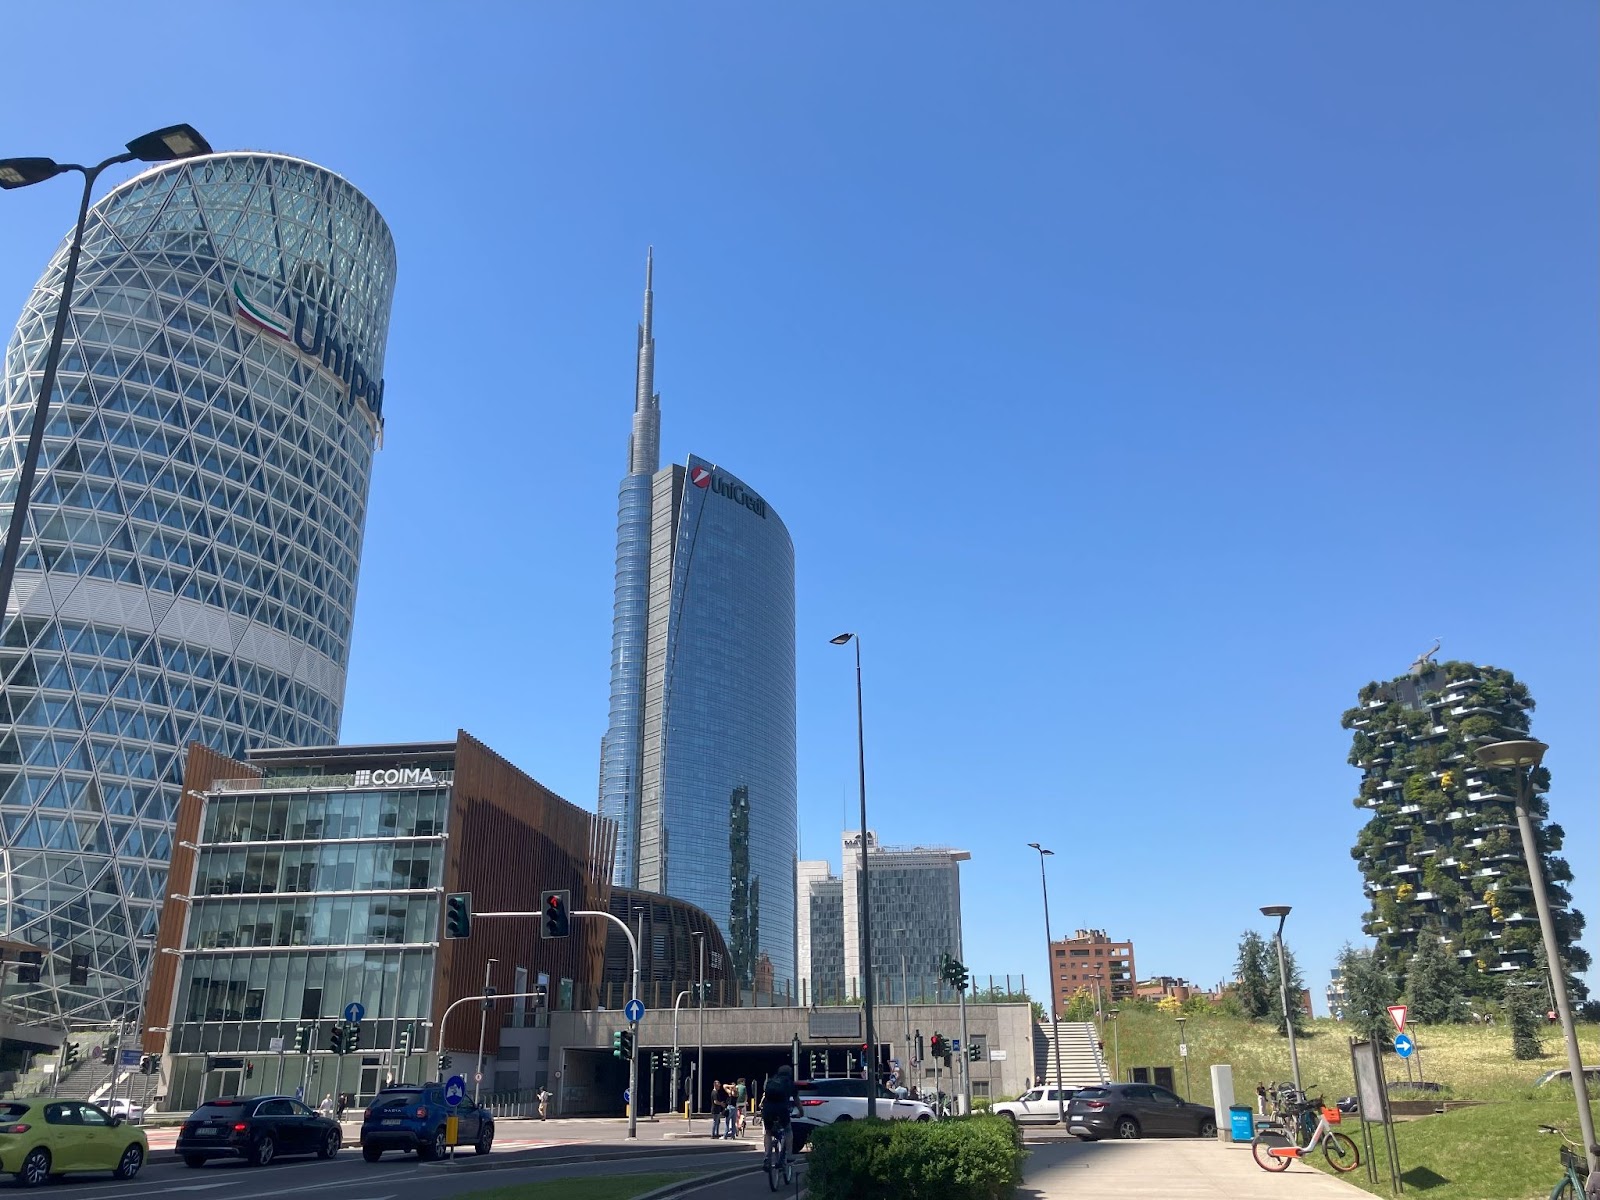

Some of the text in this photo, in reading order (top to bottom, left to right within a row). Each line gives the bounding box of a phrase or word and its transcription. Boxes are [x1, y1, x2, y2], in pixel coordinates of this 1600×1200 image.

[295, 299, 384, 420] Unipol
[711, 474, 766, 519] UniCredit
[372, 768, 433, 784] COIMA
